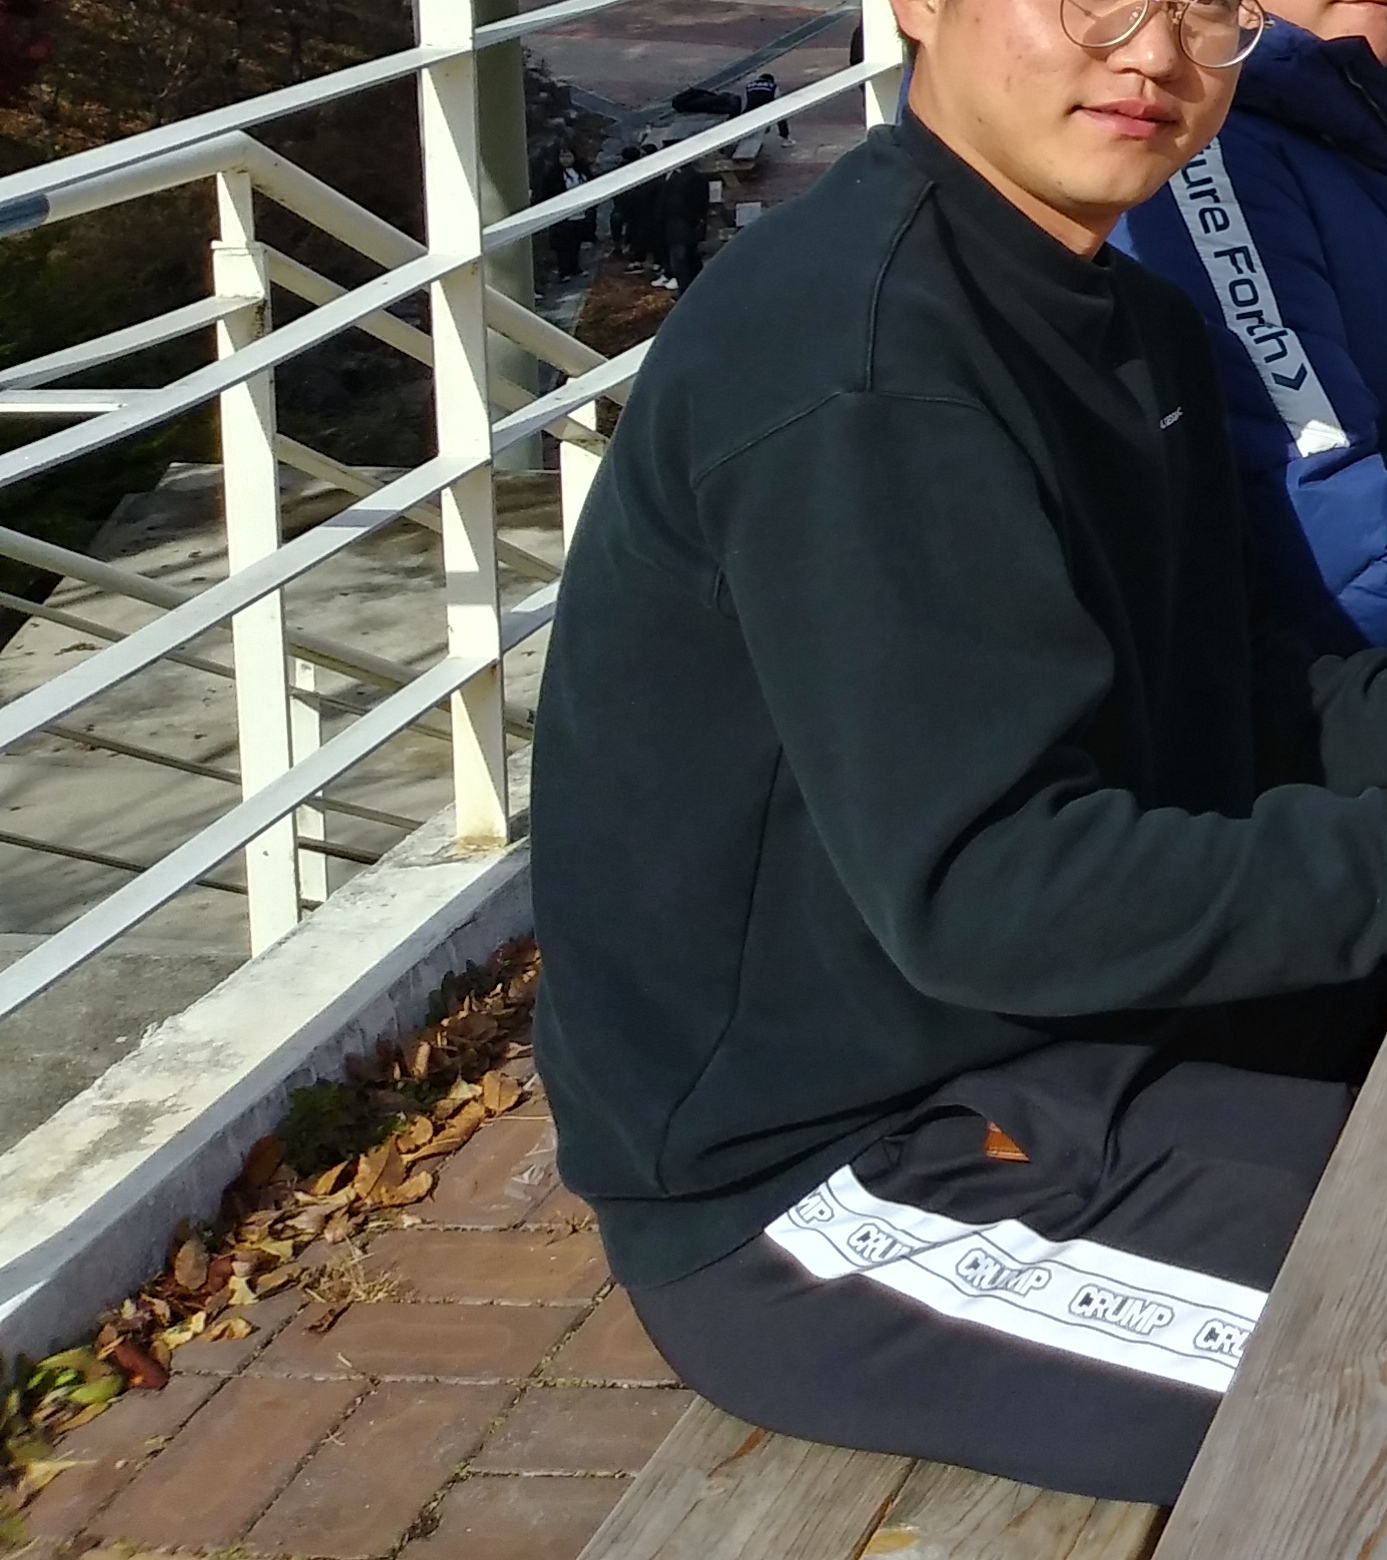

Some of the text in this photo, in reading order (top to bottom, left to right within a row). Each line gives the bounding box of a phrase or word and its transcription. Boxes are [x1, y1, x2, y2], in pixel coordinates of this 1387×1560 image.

[1181, 146, 1231, 234] ure
[955, 1247, 1052, 1297] CRUMP
[1068, 1283, 1175, 1336] CRUMP
